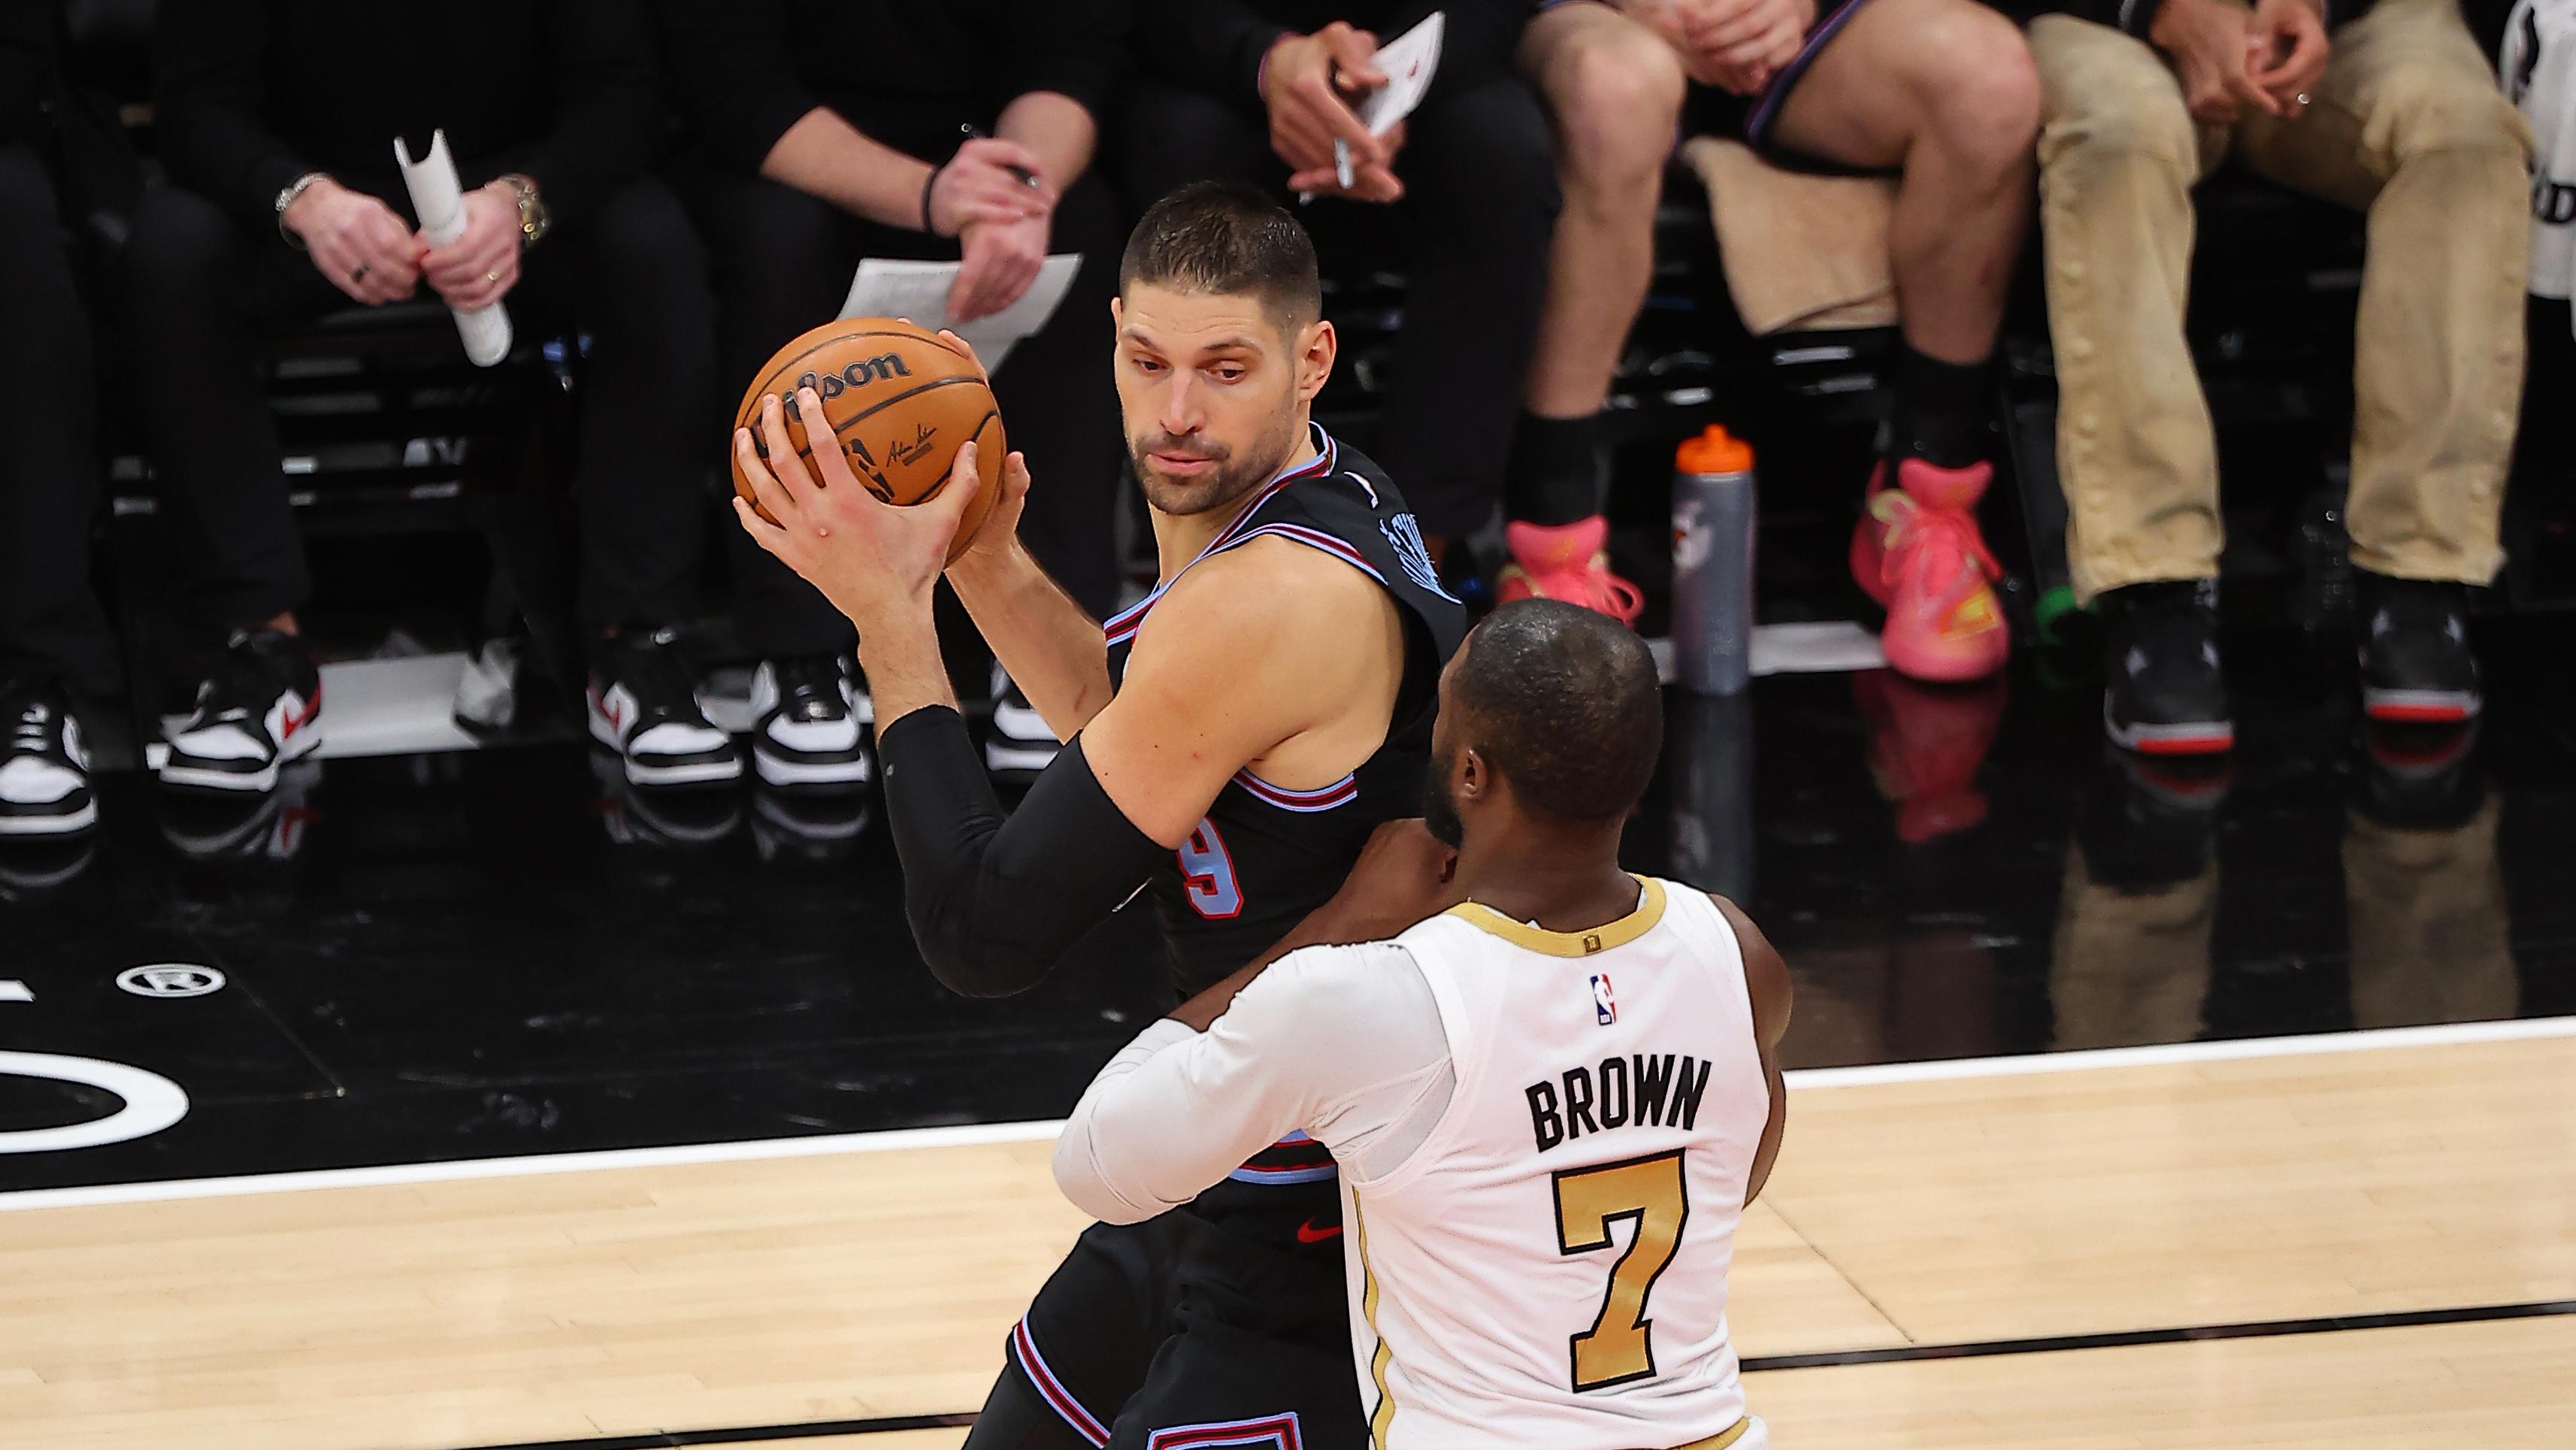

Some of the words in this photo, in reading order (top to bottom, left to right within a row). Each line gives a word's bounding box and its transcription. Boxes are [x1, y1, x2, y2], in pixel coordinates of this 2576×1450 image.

[752, 353, 910, 459] ison
[1176, 814, 1245, 920] 9
[1524, 1054, 1712, 1153] BROWN
[1551, 1147, 1690, 1394] 7
